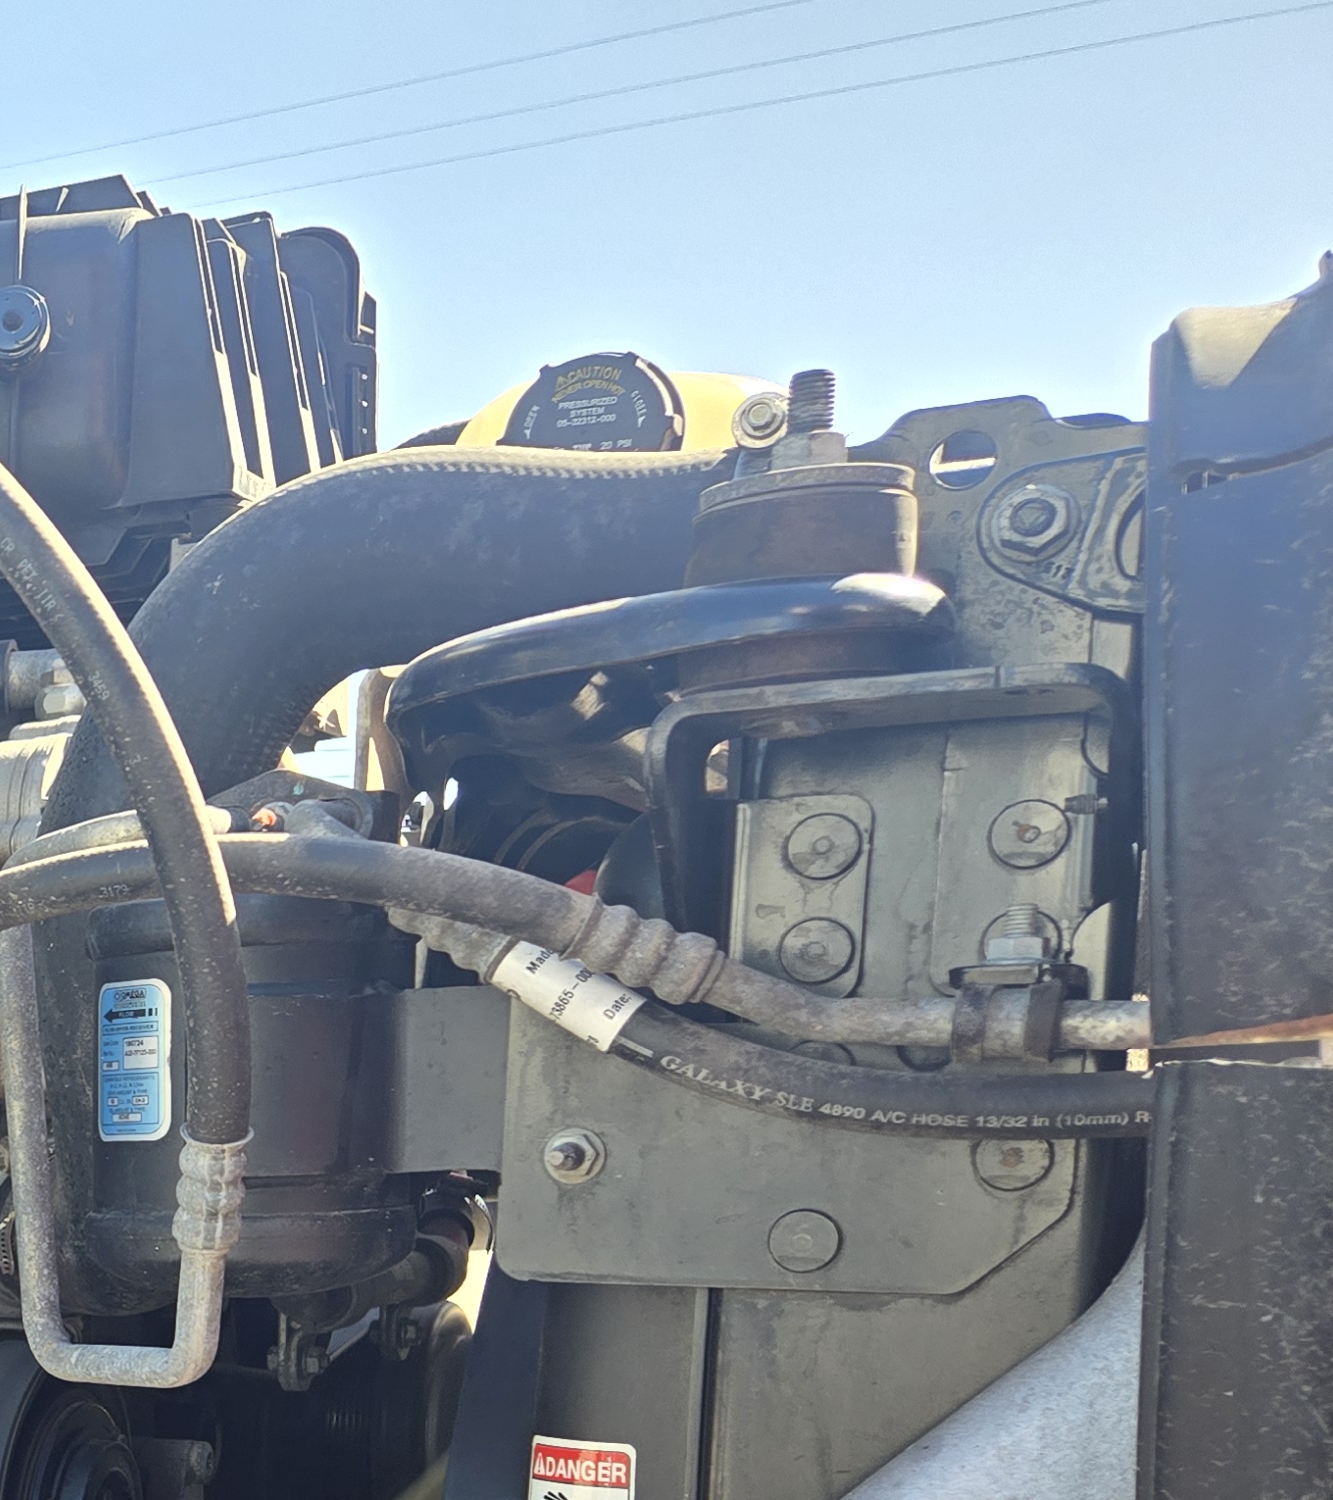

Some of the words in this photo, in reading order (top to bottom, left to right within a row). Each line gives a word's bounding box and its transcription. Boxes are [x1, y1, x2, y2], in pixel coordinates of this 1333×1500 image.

[567, 365, 622, 381] CAUTION
[551, 381, 582, 403] NEVER
[584, 379, 607, 390] OPEN
[607, 382, 626, 397] HOT
[558, 395, 618, 410] PRESSURIZED
[569, 406, 605, 418] SYSTEM
[600, 440, 613, 450] 20
[616, 438, 633, 448] PSI
[602, 993, 633, 1020] Date:
[659, 1055, 772, 1101] GALAXY
[773, 1091, 815, 1112] SLE
[817, 1102, 866, 1120] 4890
[870, 1109, 907, 1125] A/C
[911, 1112, 970, 1128] HOSE
[974, 1114, 1028, 1128] 13/32
[1032, 1113, 1050, 1127] in
[1056, 1111, 1130, 1128] (10mm)
[545, 1456, 627, 1484] DANGER
